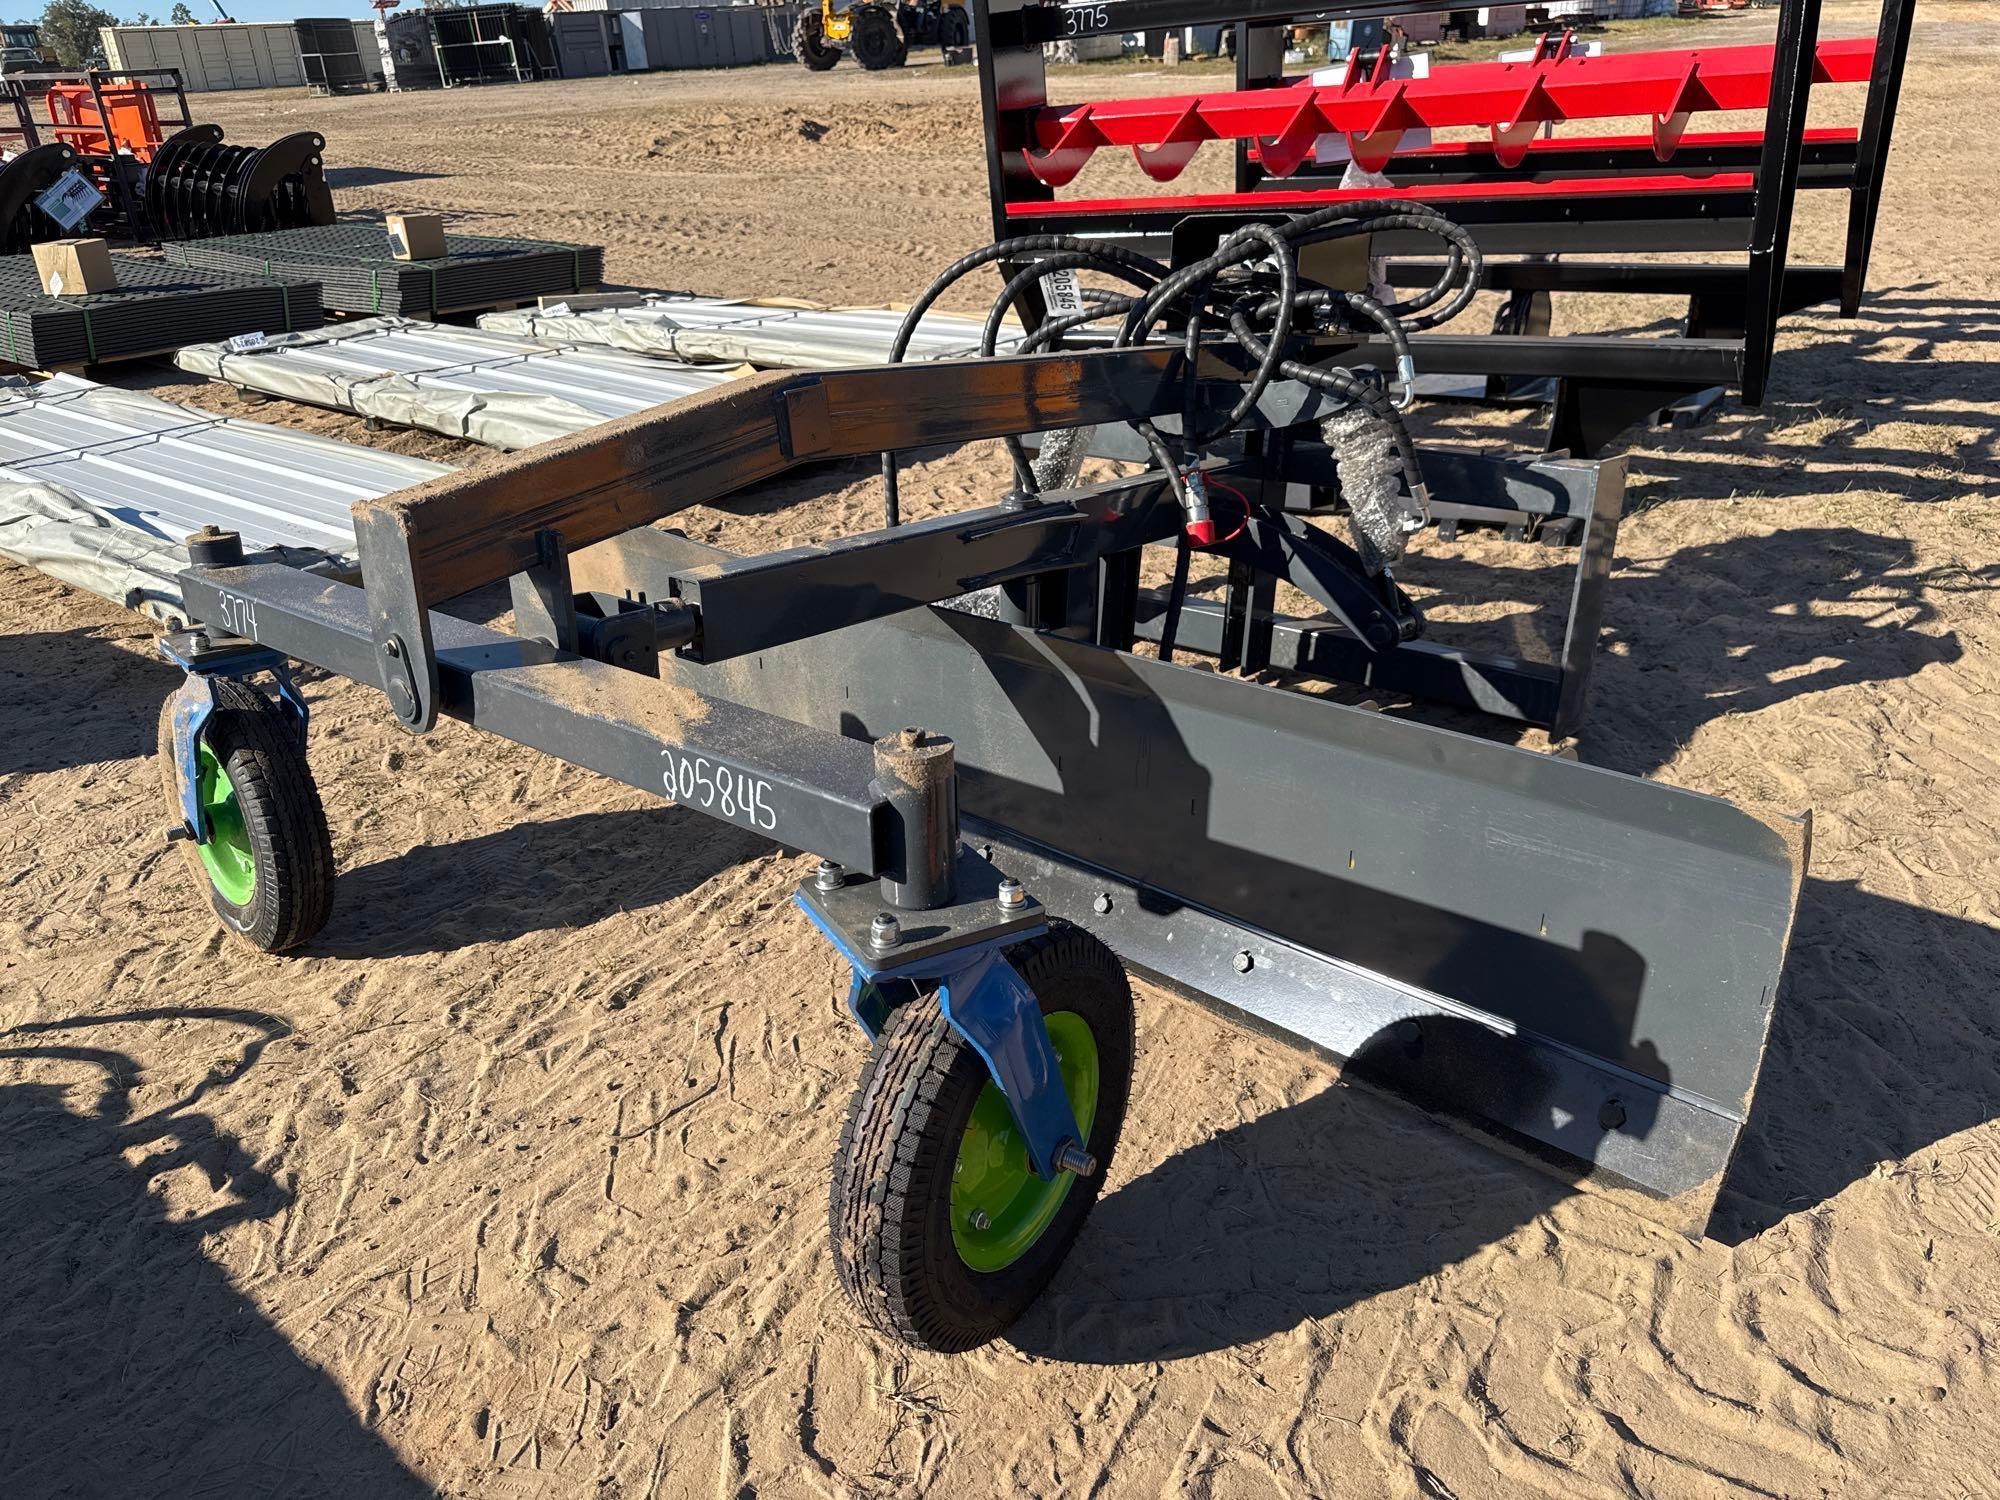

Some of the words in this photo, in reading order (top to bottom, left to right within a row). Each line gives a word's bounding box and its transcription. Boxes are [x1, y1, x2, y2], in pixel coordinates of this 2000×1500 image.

[1065, 5, 1109, 35] 3775
[1053, 270, 1077, 310] 205845
[219, 590, 258, 642] 3774
[660, 749, 777, 830] 205845
